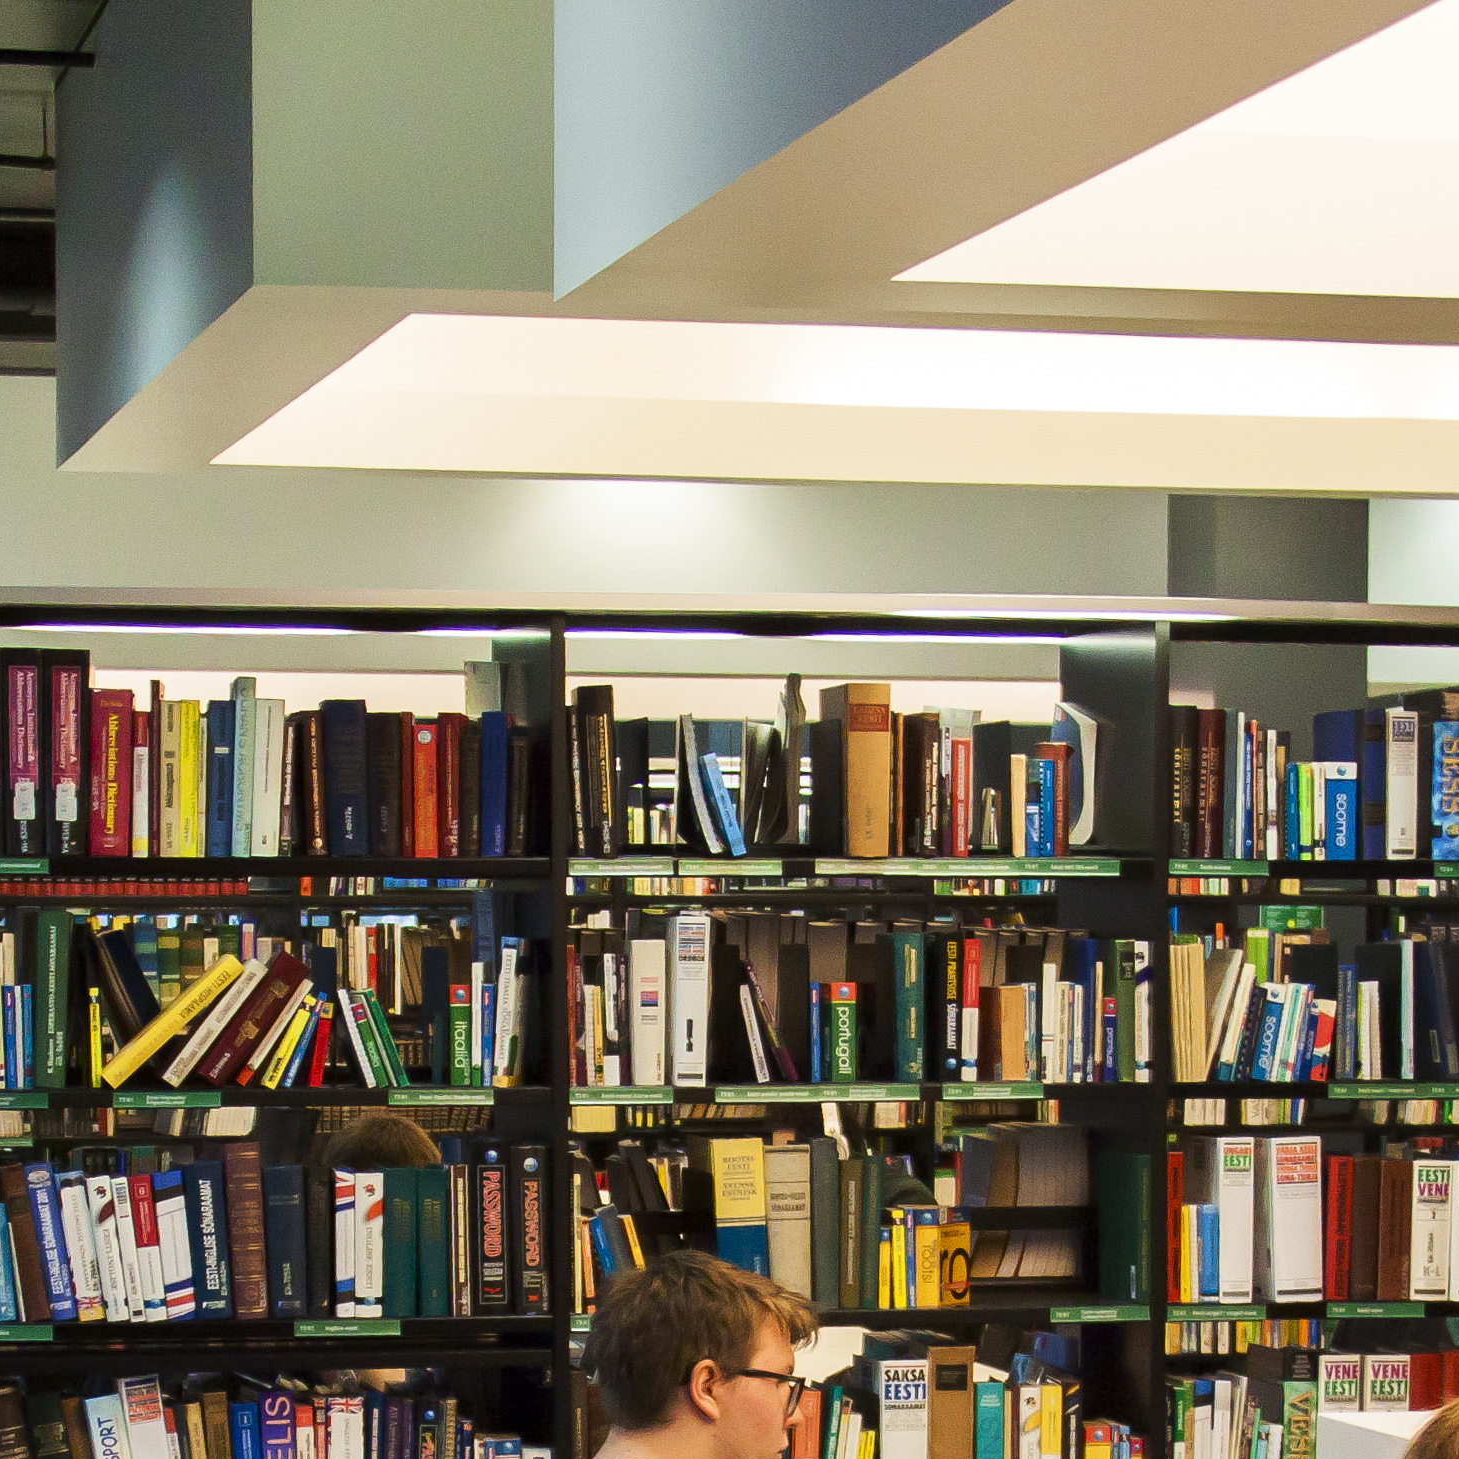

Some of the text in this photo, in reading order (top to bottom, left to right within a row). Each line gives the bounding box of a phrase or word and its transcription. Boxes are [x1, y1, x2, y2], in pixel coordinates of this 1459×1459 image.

[106, 712, 119, 780] Abbreviations
[103, 782, 119, 836] Dictionary
[1334, 792, 1349, 848] soome
[453, 1020, 468, 1069] itaalia
[835, 1006, 853, 1075] portugali
[1257, 1014, 1277, 1069] soome
[1417, 1182, 1450, 1198] VENE
[1418, 1169, 1451, 1183] EESTI
[197, 1178, 216, 1234] SÕNARAAMAT
[482, 1171, 503, 1258] PASSWORD
[523, 1180, 542, 1268] PASSWORD
[920, 1244, 935, 1284] rootsi
[884, 1368, 926, 1383] SAKSA
[884, 1383, 927, 1401] EESTI
[1324, 1364, 1359, 1380] VENE
[1324, 1379, 1358, 1396] EESTI
[1371, 1363, 1408, 1379] VENE
[1371, 1379, 1408, 1396] EESTI
